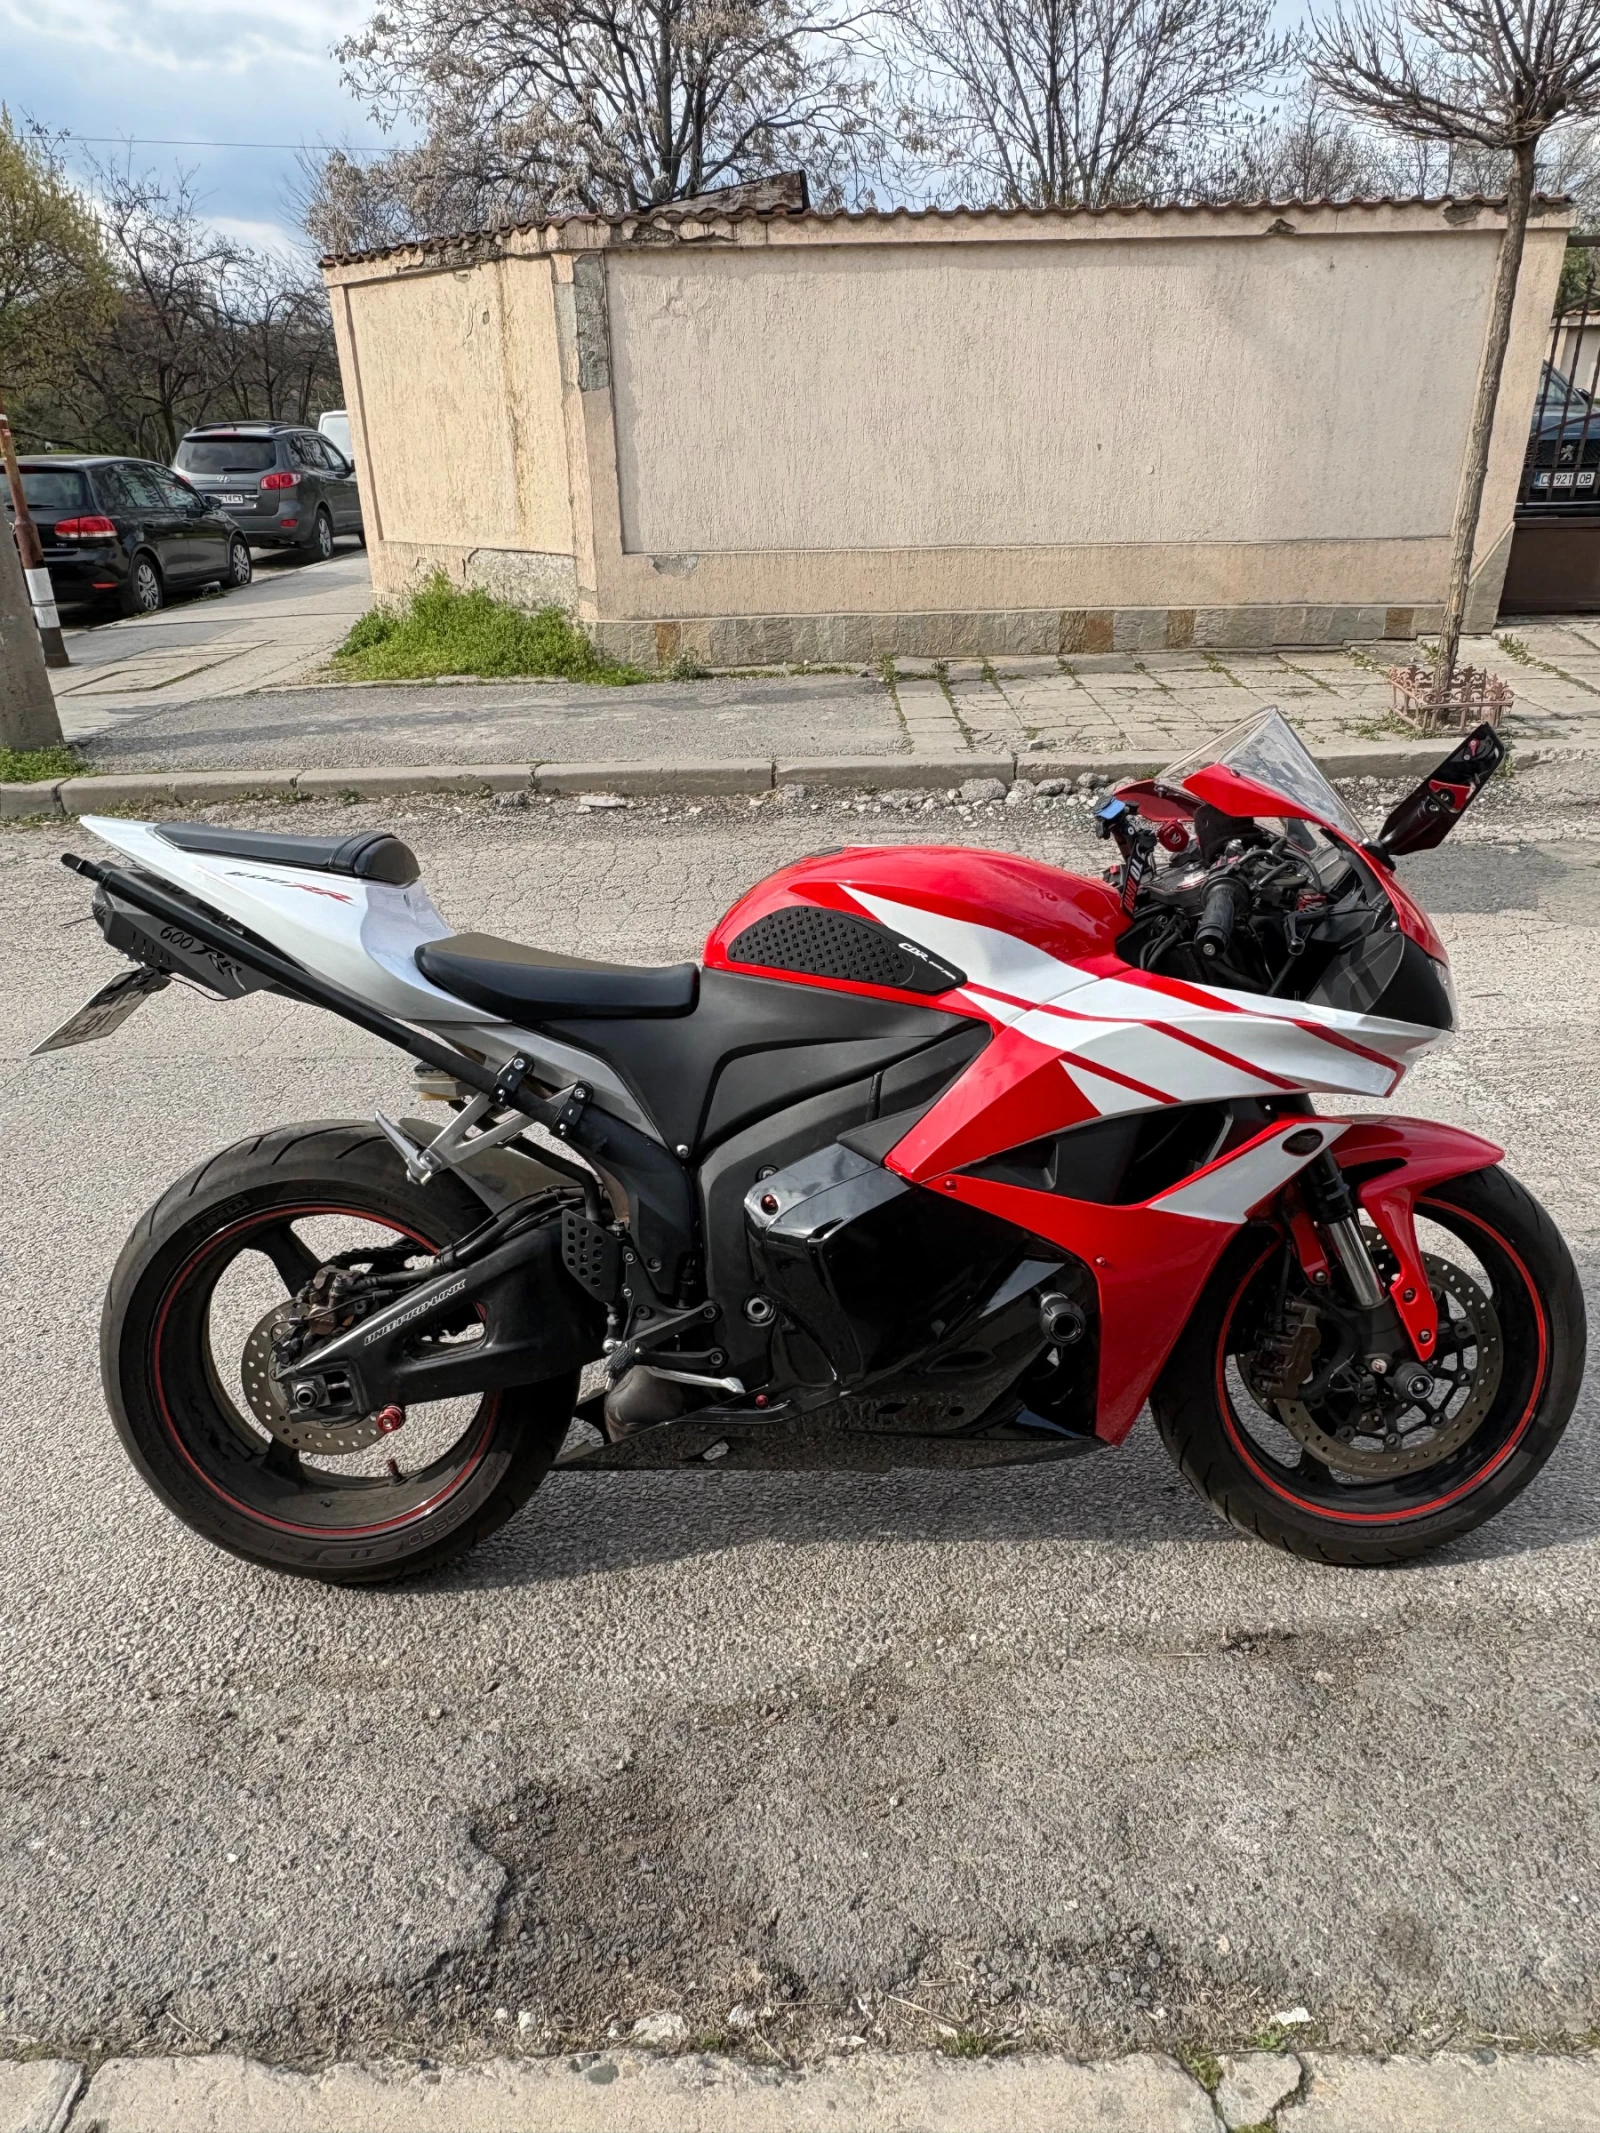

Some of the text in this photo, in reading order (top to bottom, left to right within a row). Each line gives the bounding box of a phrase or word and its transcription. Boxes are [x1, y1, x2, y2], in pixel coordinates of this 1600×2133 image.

[160, 926, 194, 949] 600
[364, 1279, 467, 1346] UNIT PRO-LINK
[408, 1502, 471, 1546] ROSSO
